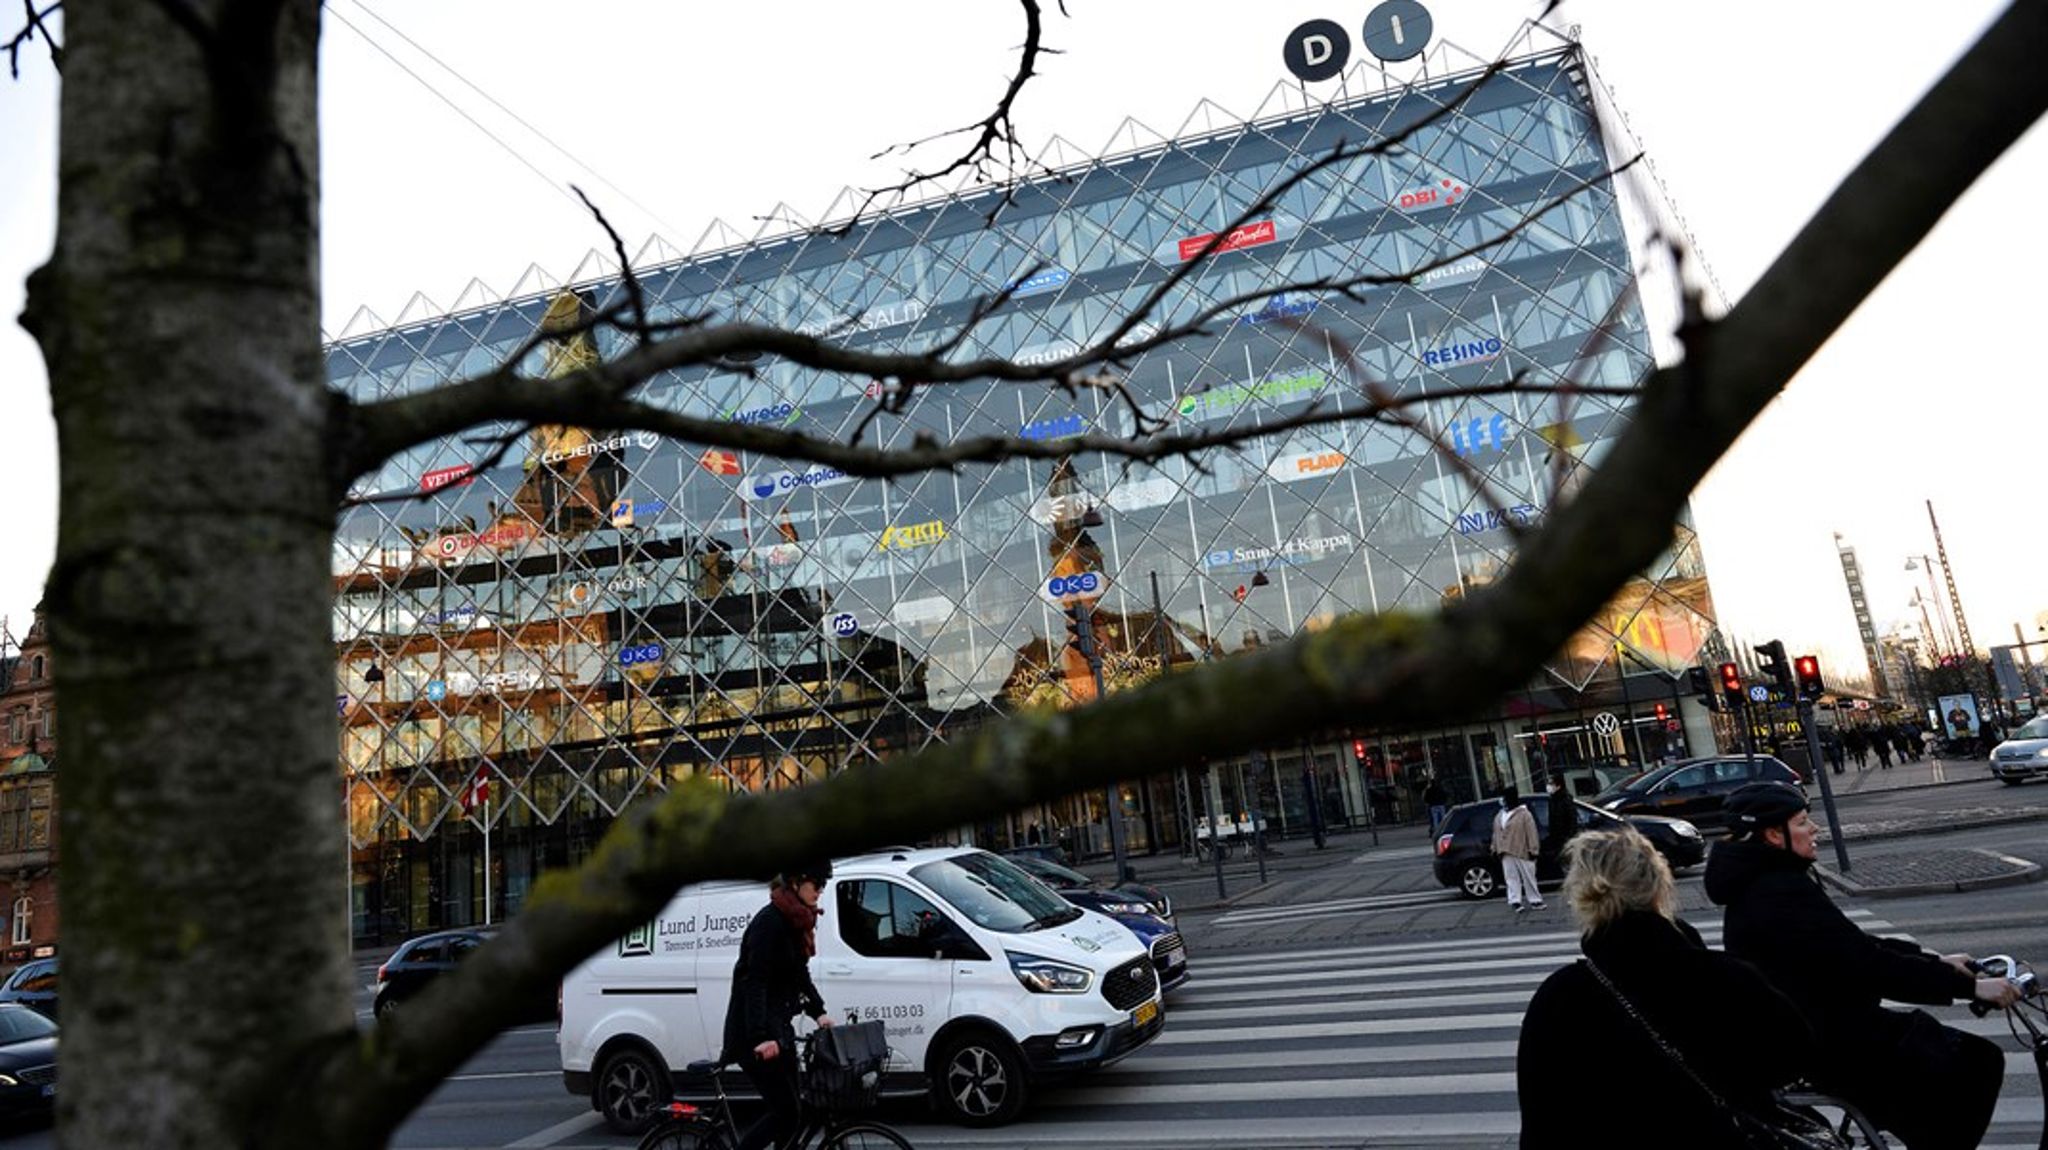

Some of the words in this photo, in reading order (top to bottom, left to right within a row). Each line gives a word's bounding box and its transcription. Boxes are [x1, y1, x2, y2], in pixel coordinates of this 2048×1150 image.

[1303, 34, 1333, 66] D
[1400, 188, 1437, 208] DBI
[1426, 259, 1487, 283] JULIANA
[1424, 338, 1502, 365] RESINO
[1451, 413, 1505, 456] iff
[1298, 453, 1345, 472] FLAM
[1298, 533, 1350, 553] Kappa
[1053, 576, 1096, 593] JKS
[622, 646, 661, 663] JKS
[659, 916, 697, 936] Lund
[702, 912, 752, 932] Junget
[865, 1006, 879, 1018] 66
[881, 1006, 892, 1018] 11
[893, 1005, 908, 1018] 03
[909, 1004, 924, 1017] 03
